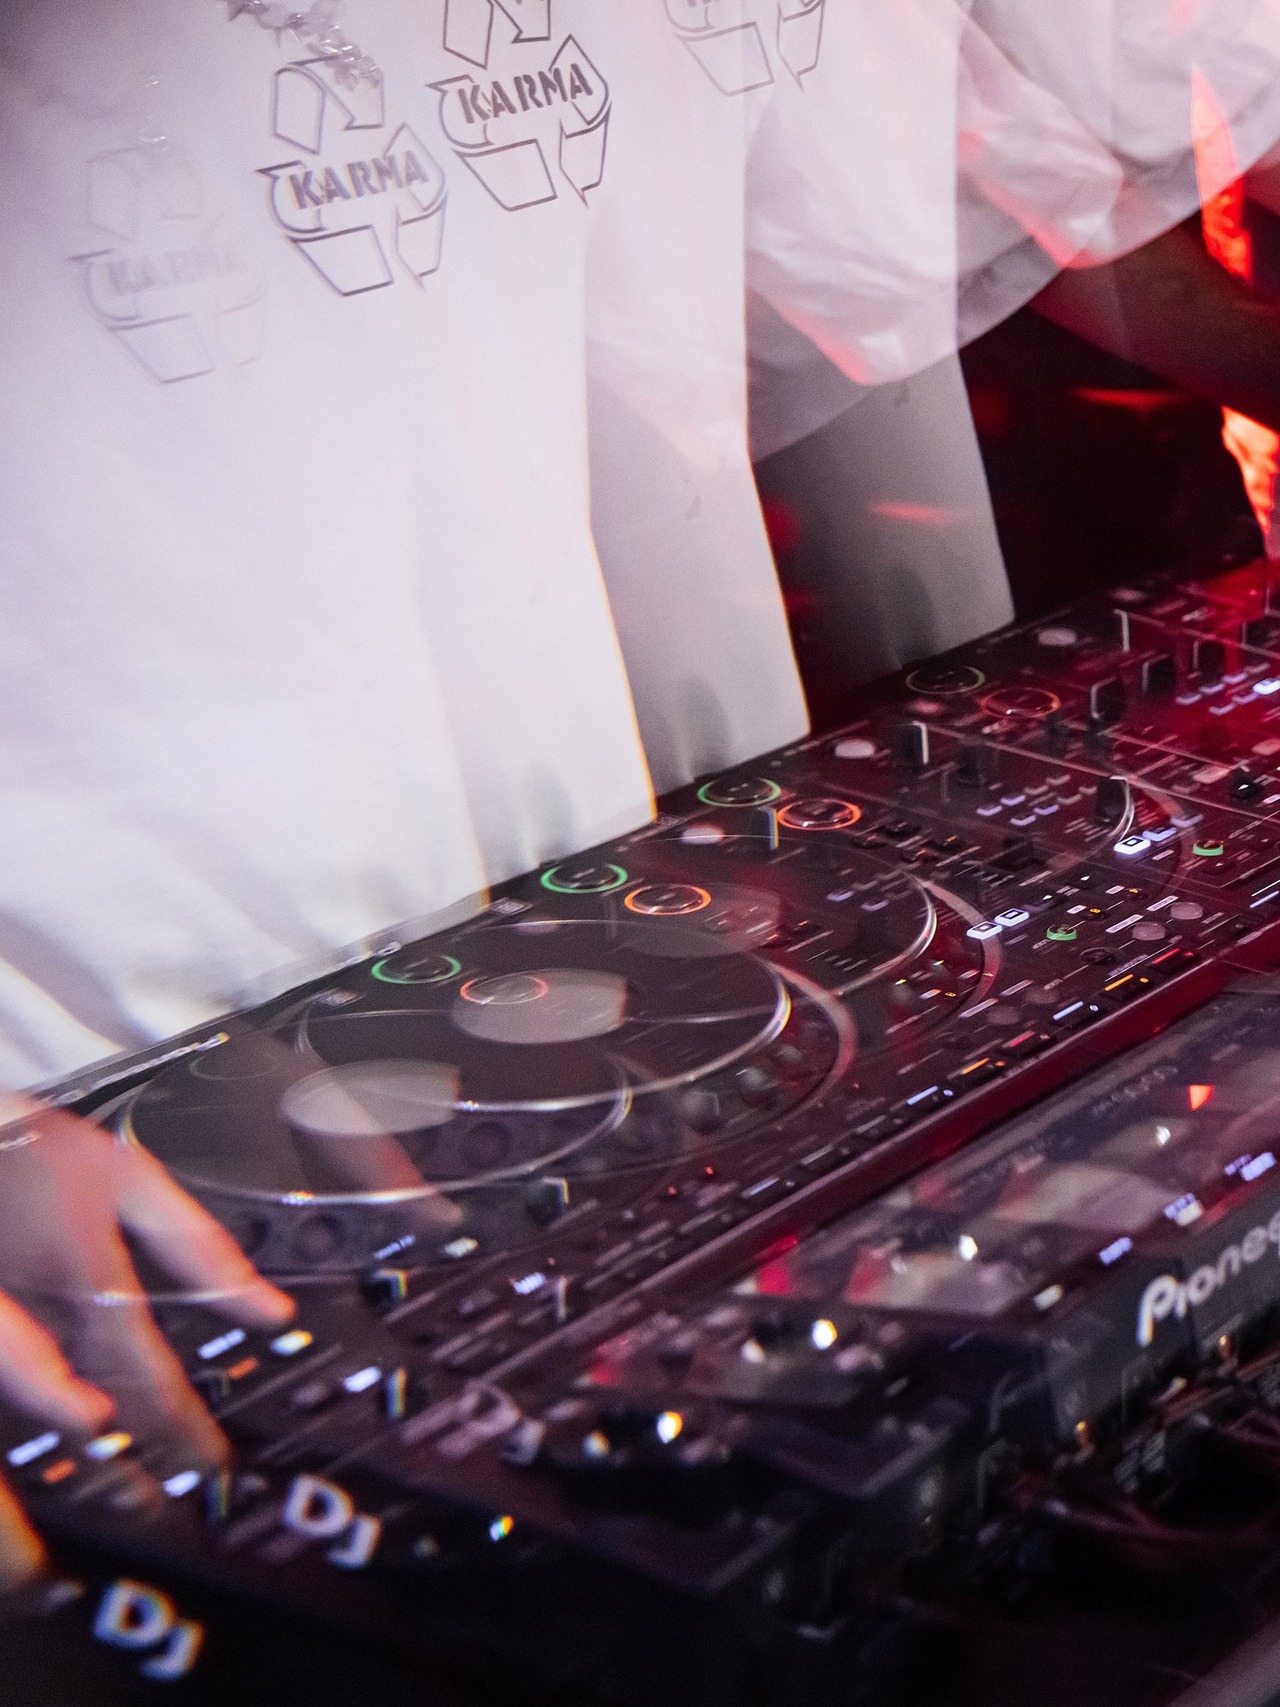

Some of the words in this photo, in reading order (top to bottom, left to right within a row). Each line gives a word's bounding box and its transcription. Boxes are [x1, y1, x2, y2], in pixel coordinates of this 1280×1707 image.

[457, 62, 593, 125] KARMA
[288, 149, 430, 211] KARMA
[284, 1475, 380, 1568] DJ
[93, 1578, 204, 1682] DJ
